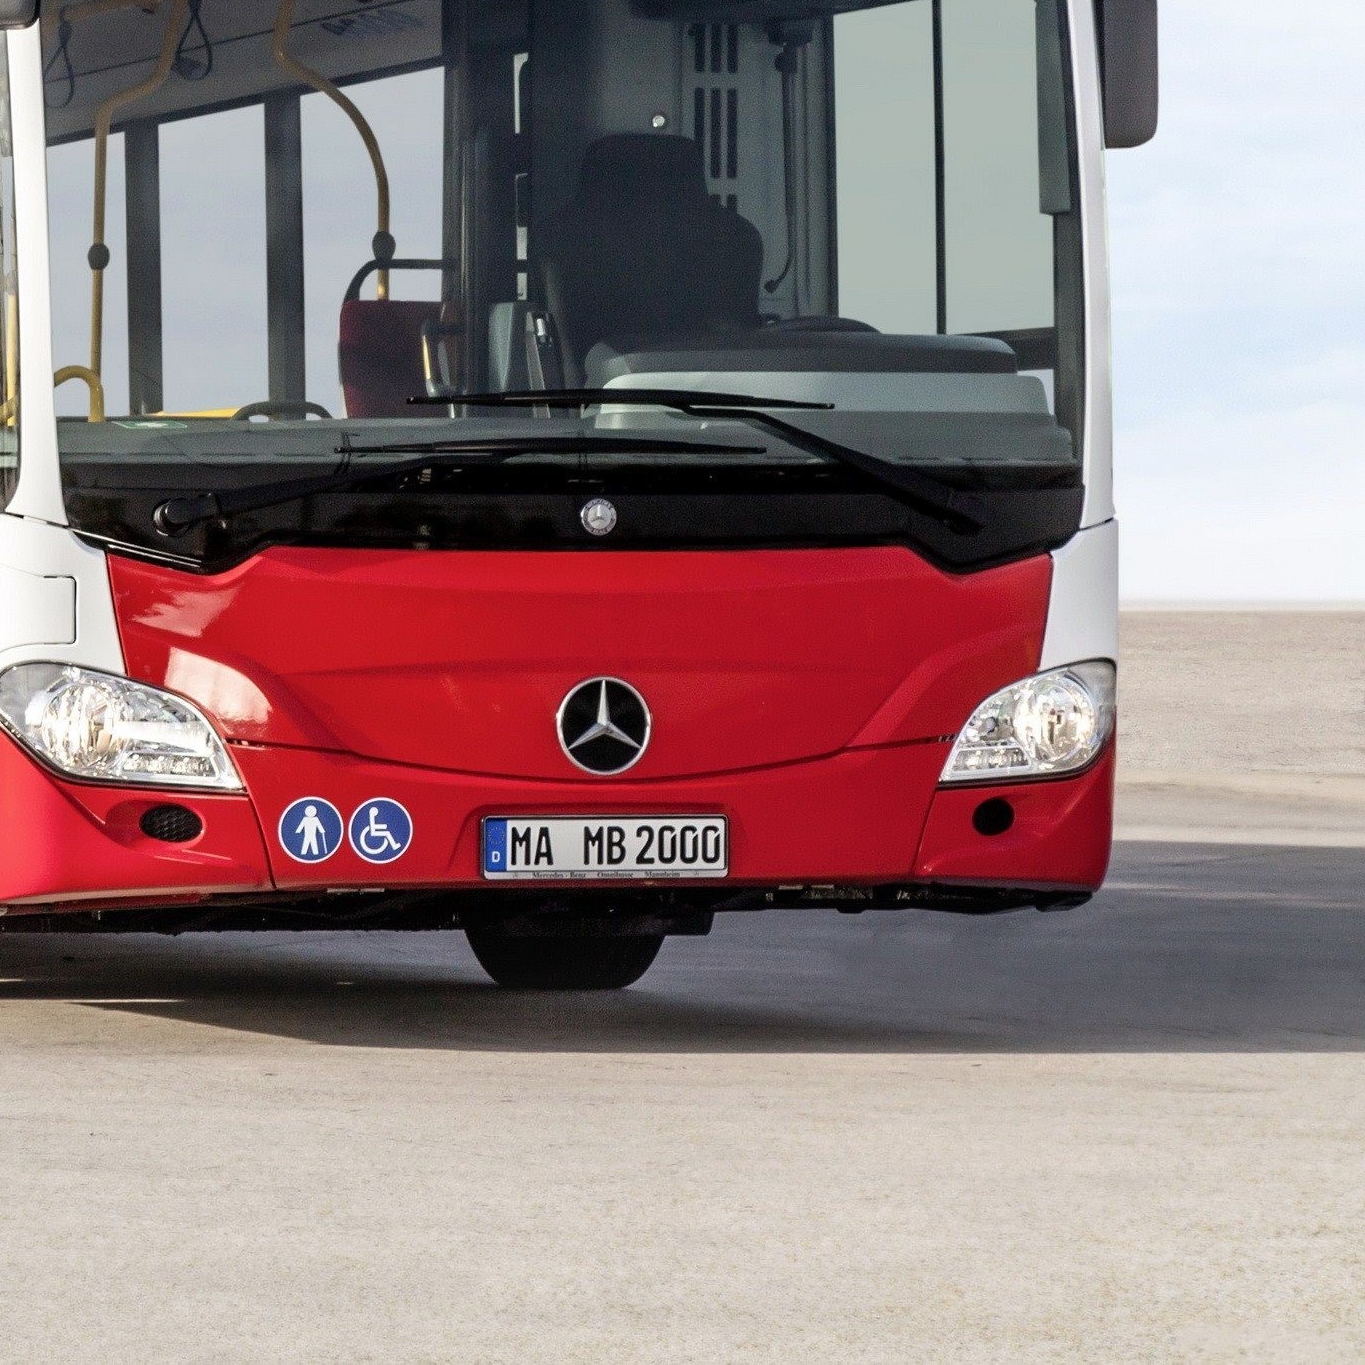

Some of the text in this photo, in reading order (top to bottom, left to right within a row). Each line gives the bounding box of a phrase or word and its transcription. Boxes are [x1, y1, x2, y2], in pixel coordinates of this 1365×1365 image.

[491, 851, 501, 863] D
[510, 825, 721, 865] MA MB 2000
